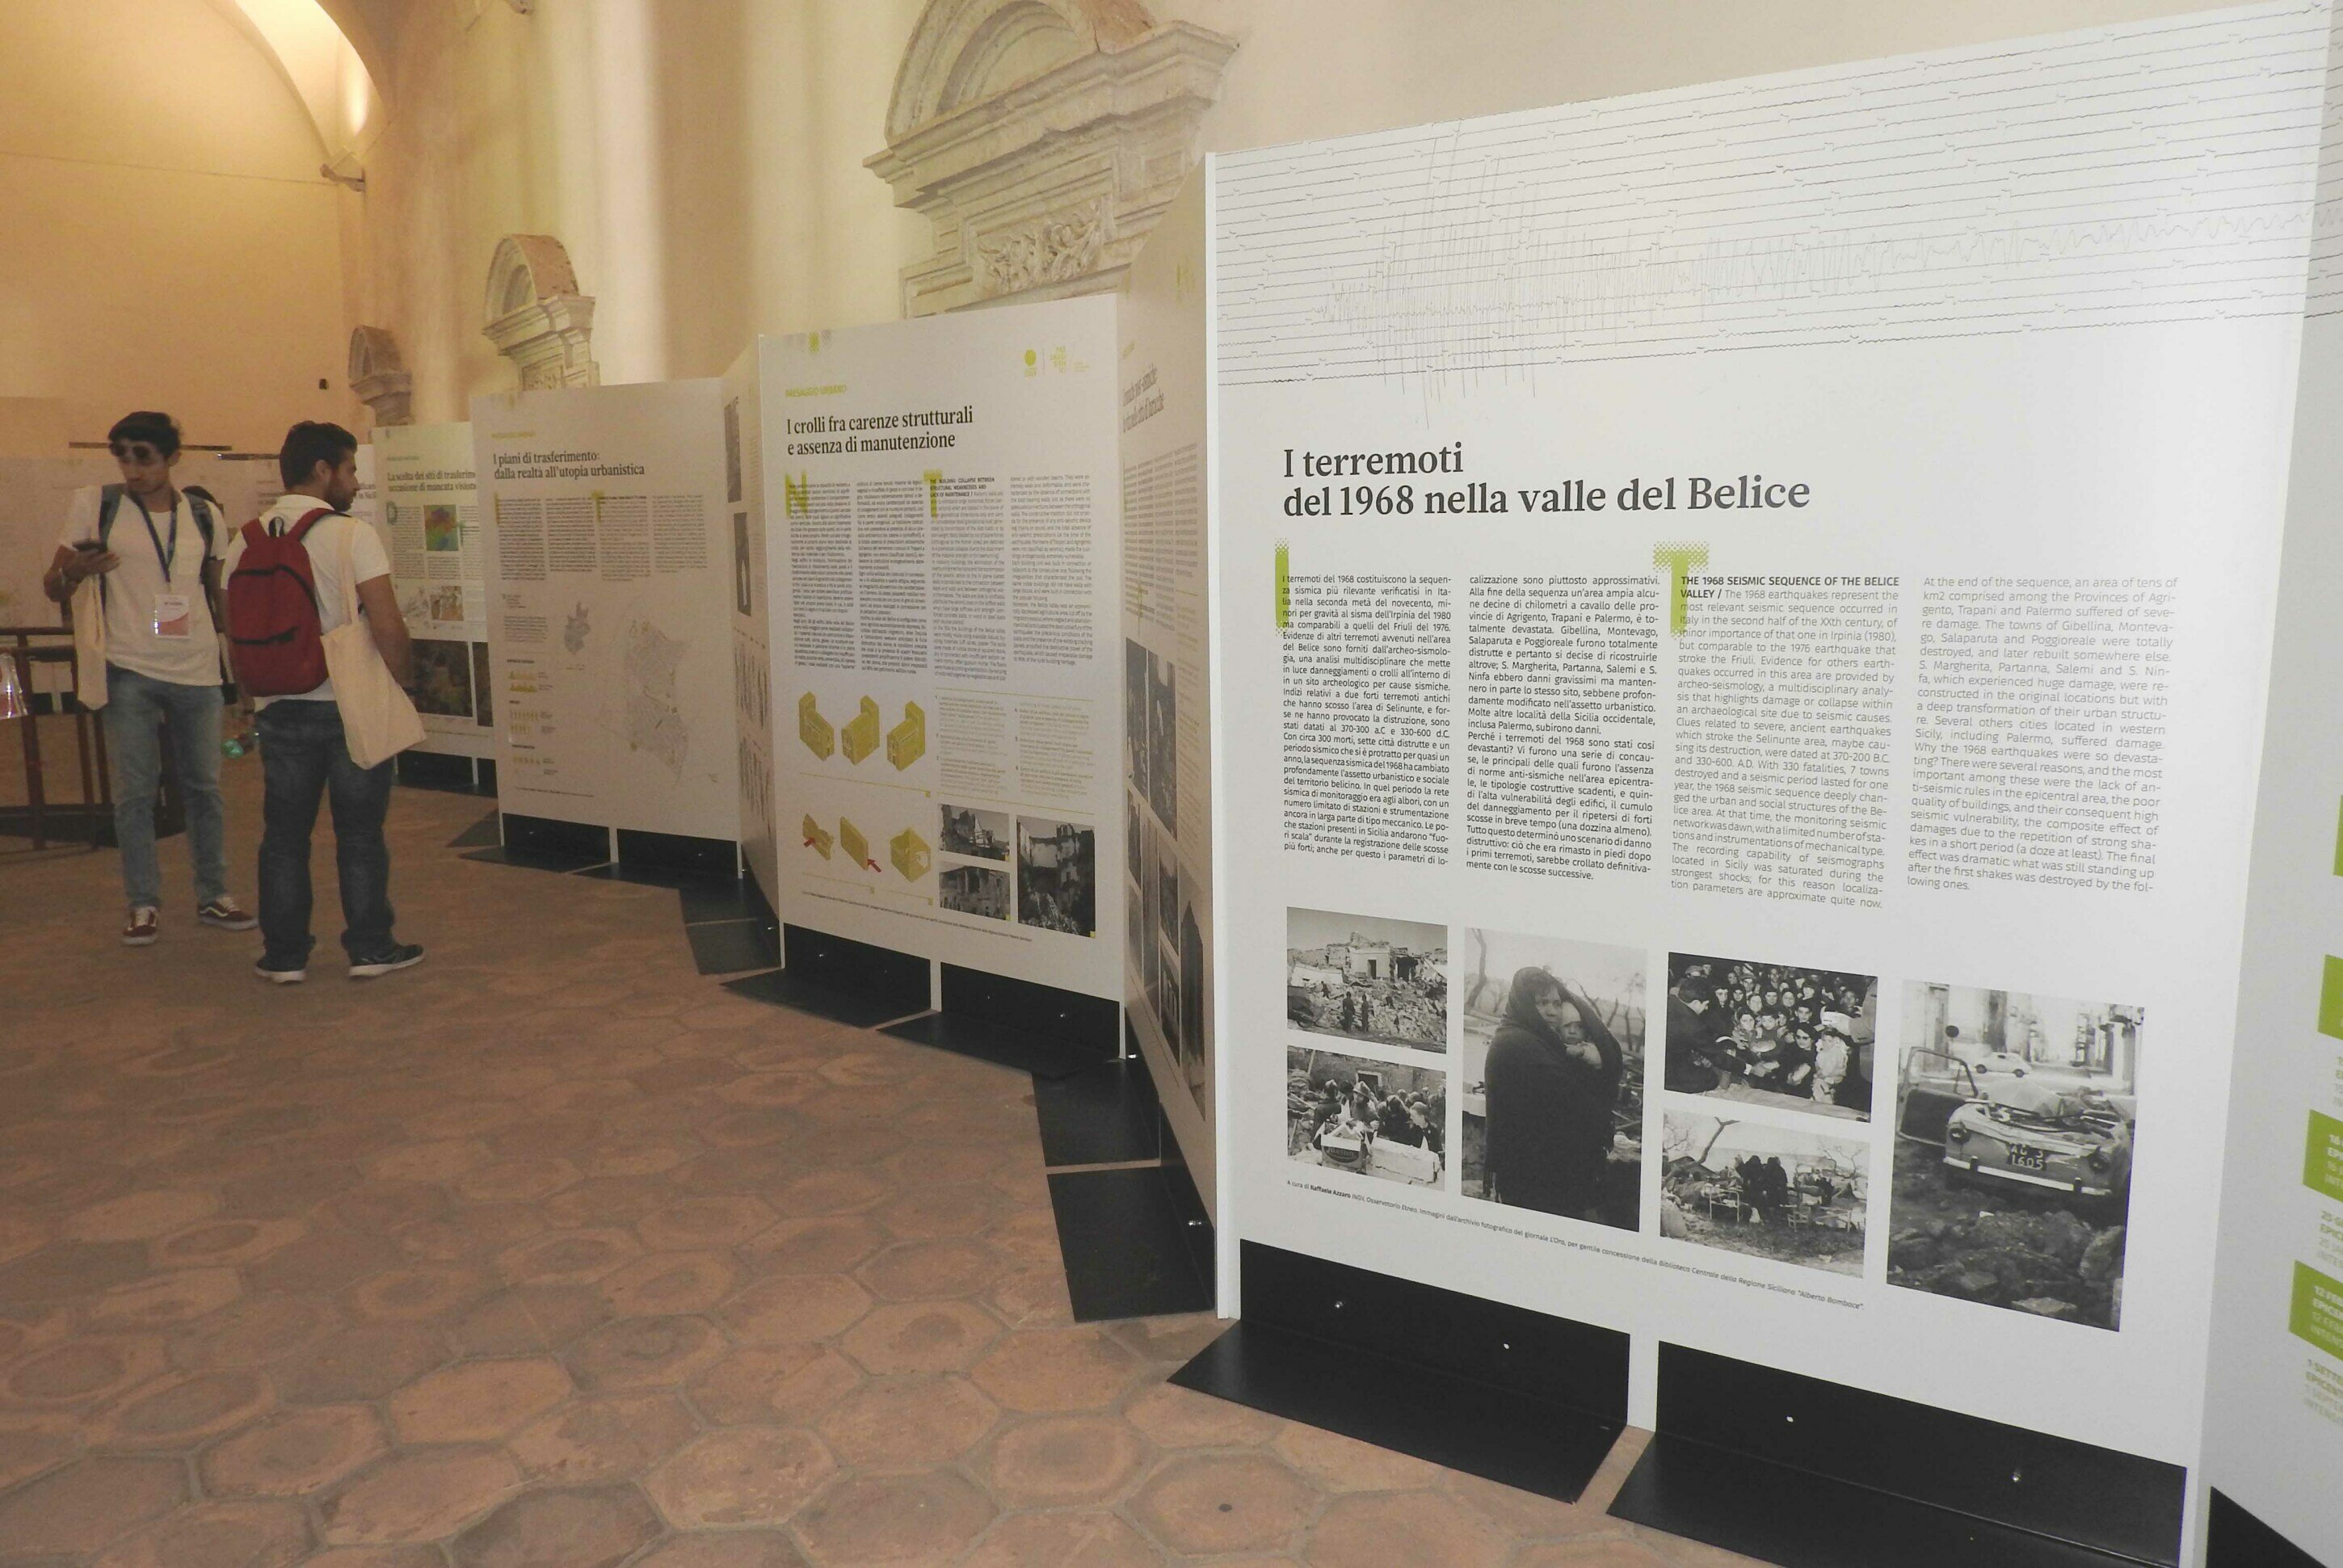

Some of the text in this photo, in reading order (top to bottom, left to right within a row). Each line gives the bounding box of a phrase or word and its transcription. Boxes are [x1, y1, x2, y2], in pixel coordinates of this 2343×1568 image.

[787, 405, 973, 435] I crolli fra carenze strutturali
[787, 431, 955, 456] e assenza di manutenzione
[493, 451, 599, 466] I piani di trasferimento:
[1283, 440, 1463, 477] I terremoti
[494, 463, 645, 480] dalla realtà all'utopia urbanistica
[1283, 474, 1810, 516] del 1968 nella valle del Belice
[1289, 574, 1321, 583] terremoti
[1323, 574, 1335, 583] del
[1337, 574, 1354, 583] 1968
[1356, 575, 1407, 583] costituiscono
[1408, 575, 1416, 583] la
[1418, 576, 1451, 585] sequen-
[1469, 575, 1660, 586] calizzazione sono piuttosto approssimativi.
[1681, 576, 1899, 586] THE 1968 SEISMIC SEQUENCE OF THE BELICE
[1924, 577, 2178, 589] At the end of the sequence, an area of tens of
[1680, 589, 1715, 599] VALLEY
[1724, 589, 1741, 599] The
[1744, 589, 1765, 599] 1968
[1768, 590, 1828, 600] earthquakes
[1831, 591, 1878, 601] represent
[1881, 591, 1899, 600] the
[1918, 659, 2170, 676] S. Margherita, Partanna, Salemi and S. Nin-
[1468, 673, 1490, 681] Ninfa
[1493, 674, 1523, 682] ebbero
[1526, 675, 1550, 683] danni
[1554, 675, 1596, 685] gravissimi
[1617, 678, 1656, 687] manten-
[1284, 843, 1449, 865] più forti; anche per questo i parametri di lo-
[1907, 876, 1970, 890] lowing ones.
[1670, 879, 1882, 909] tion parameters are approximate quite now.
[2012, 1155, 2043, 1171] 1605
[1310, 1185, 1332, 1195] Raffaele
[1333, 1189, 1351, 1199] Azzaro
[1367, 1196, 1400, 1209] Osservatorio
[1420, 1208, 1445, 1219] Immagini
[1446, 1215, 1480, 1226] dall'archivio
[1481, 1221, 1512, 1234] fotografico
[1525, 1232, 1549, 1242] giornale
[1580, 1244, 1601, 1253] gentile
[1601, 1249, 1640, 1261] concessione
[1642, 1256, 1658, 1265] della
[1659, 1260, 1690, 1272] Biblioteca
[1692, 1267, 1719, 1279] Centrale
[1720, 1273, 1737, 1283] della
[1739, 1277, 1766, 1289] Regione
